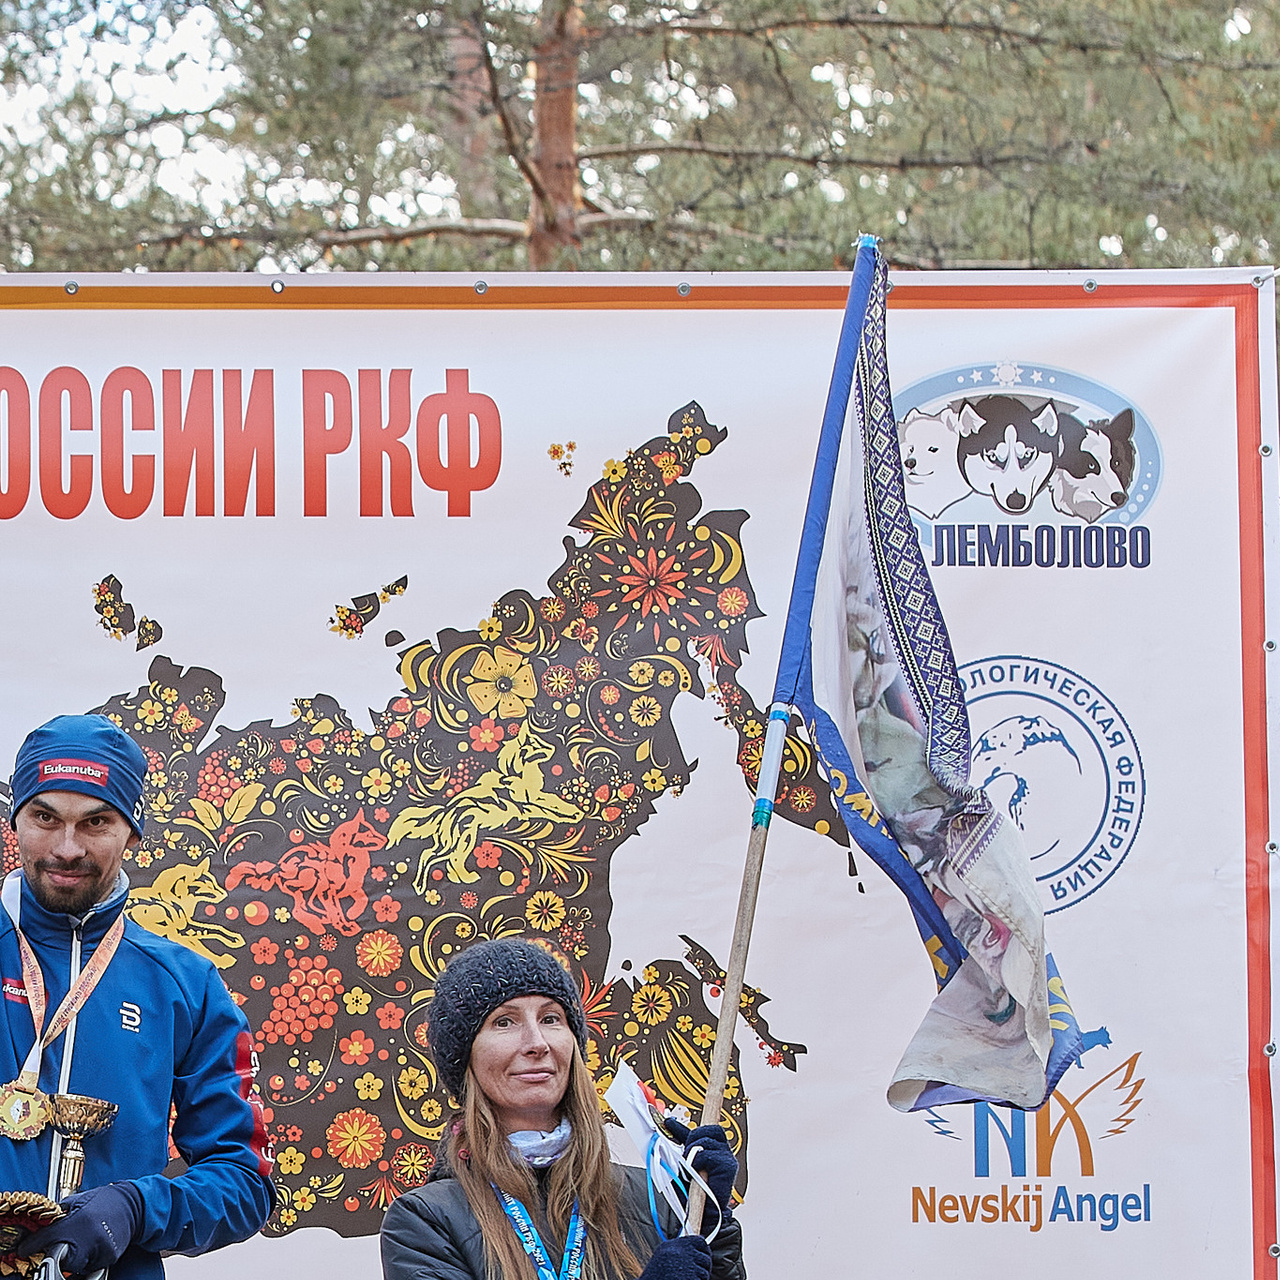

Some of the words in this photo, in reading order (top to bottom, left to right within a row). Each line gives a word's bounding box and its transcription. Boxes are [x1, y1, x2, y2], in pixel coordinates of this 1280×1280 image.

[302, 368, 502, 518] РКФ
[931, 523, 1152, 569] ЛЕМБОЛОВО
[43, 764, 103, 778] Eukanuba
[1049, 755, 1136, 901] ФЕДЕРАЦИЯ
[912, 1184, 1043, 1232] Nevskij
[1049, 1183, 1151, 1232] Angel
[510, 1206, 530, 1233] РОССИИ
[532, 1247, 546, 1266] 2021
